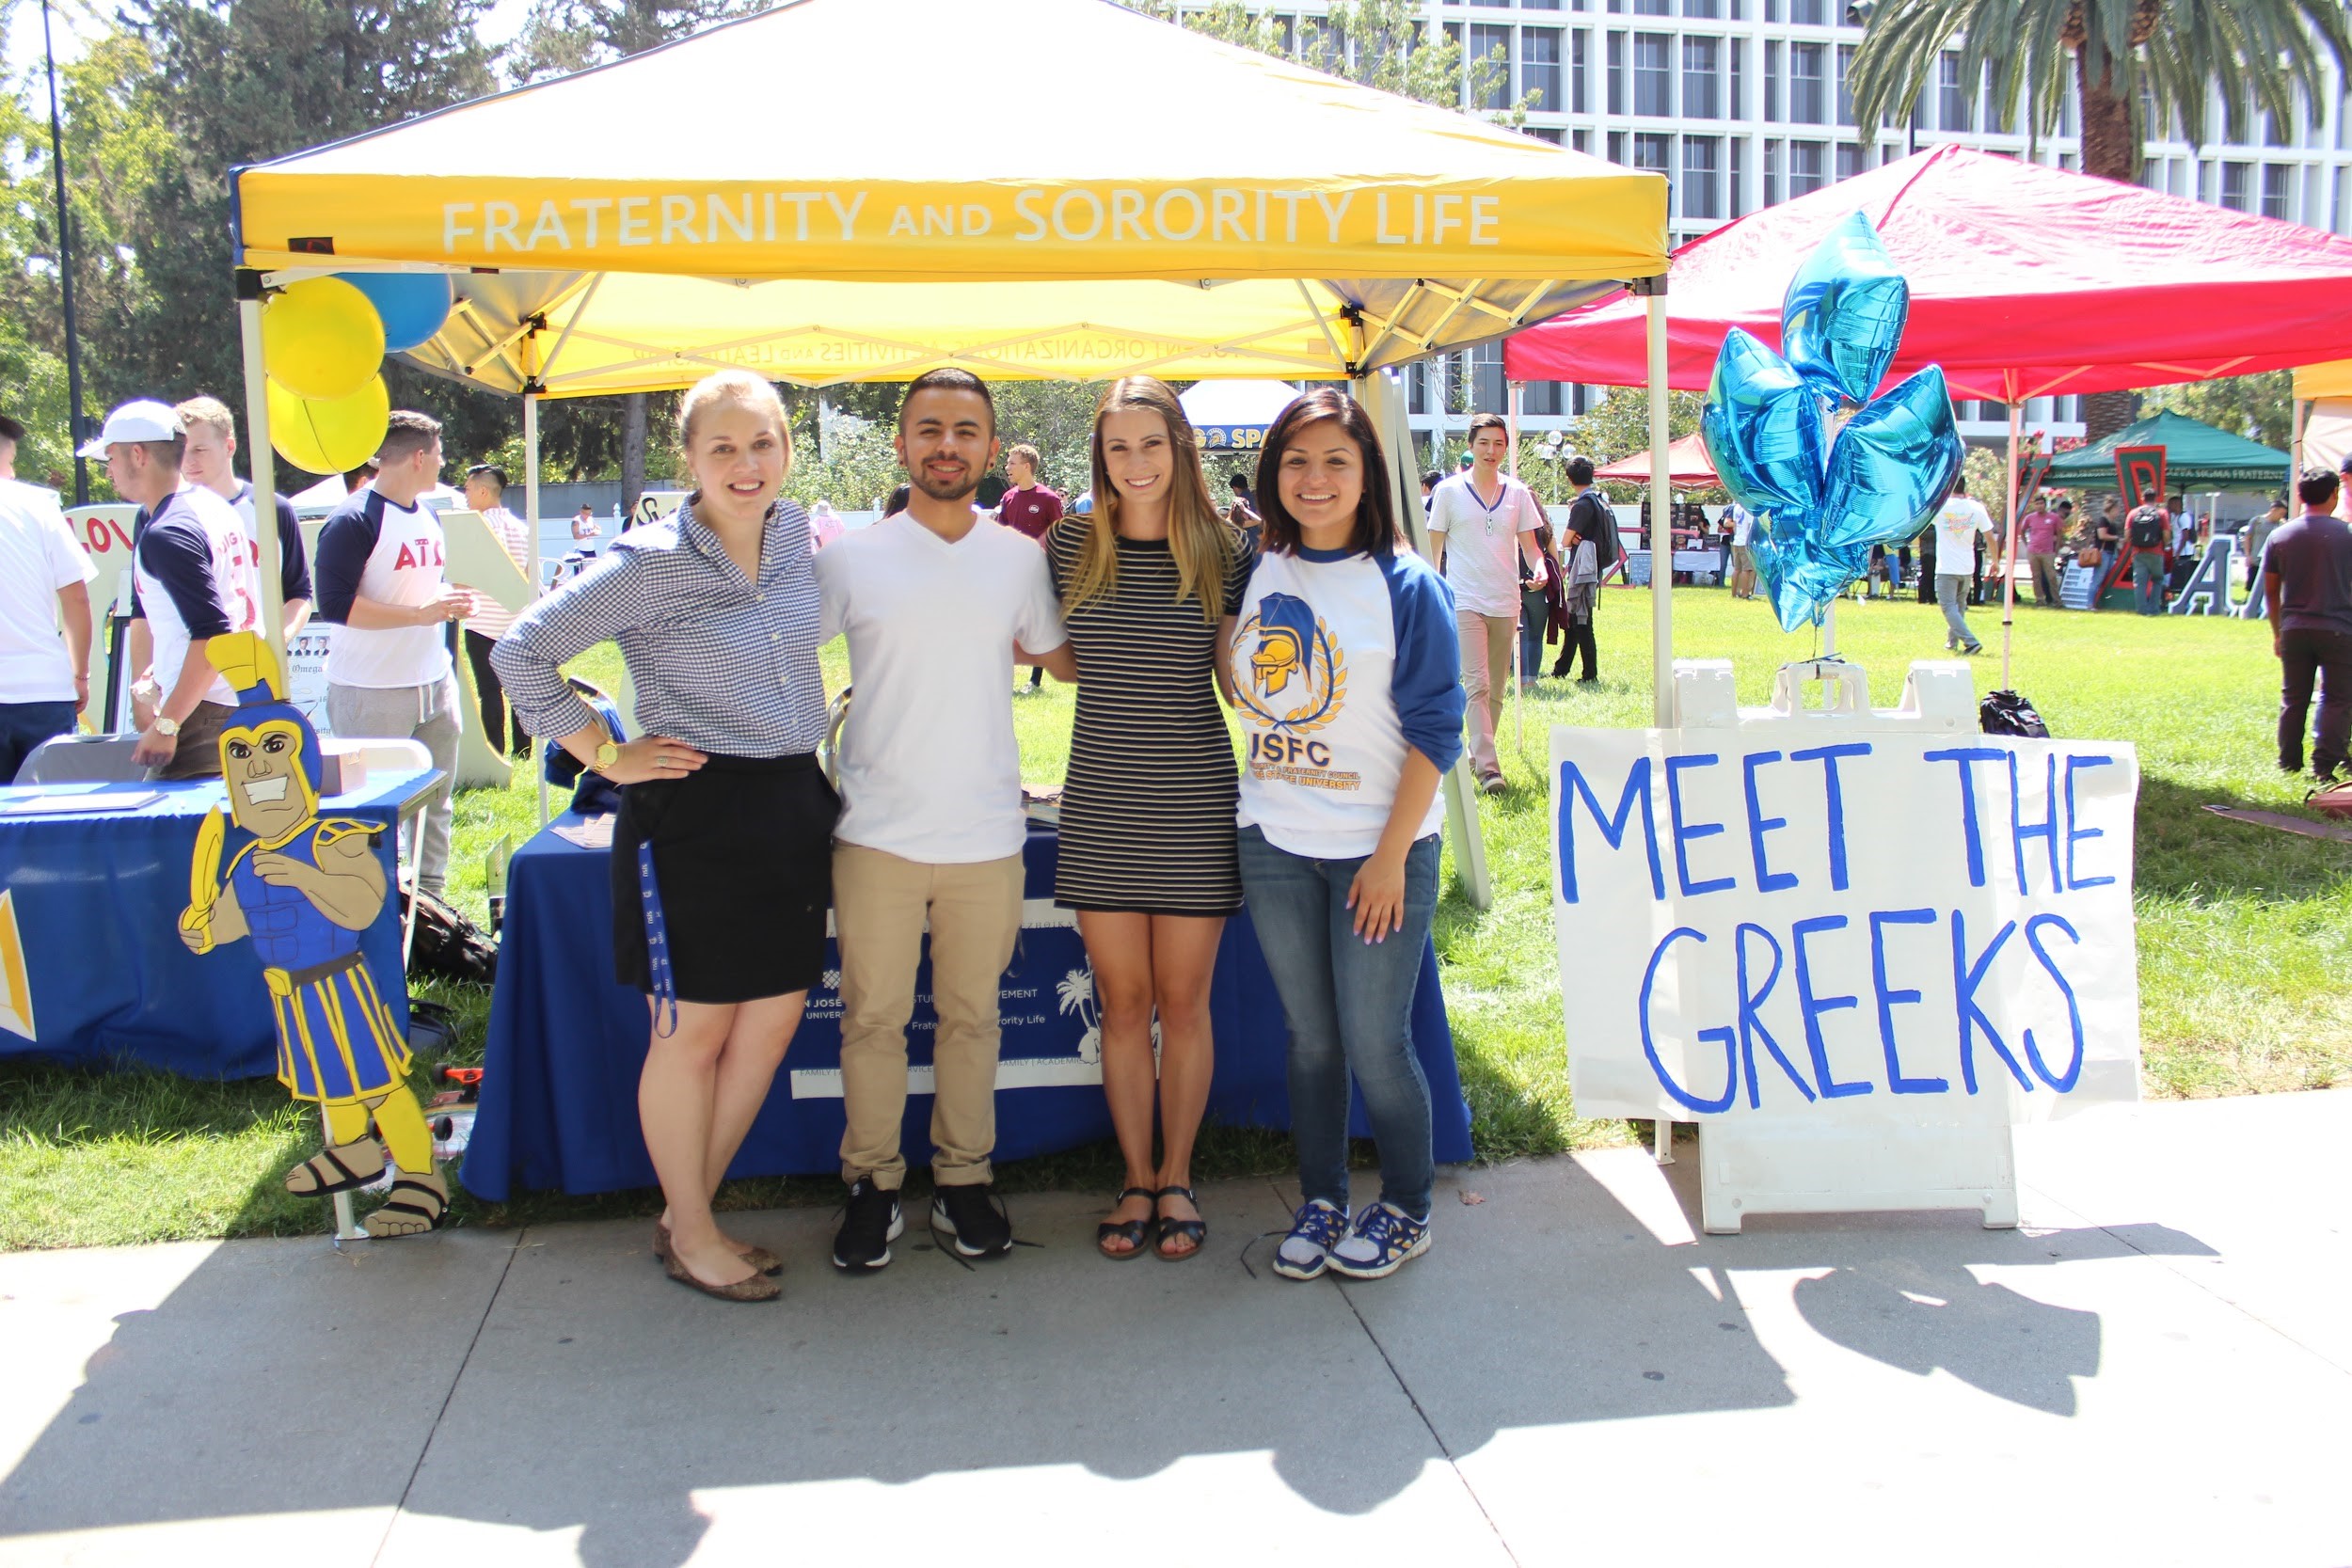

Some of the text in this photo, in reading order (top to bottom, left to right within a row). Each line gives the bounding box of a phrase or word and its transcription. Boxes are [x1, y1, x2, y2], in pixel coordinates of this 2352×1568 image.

[443, 188, 1501, 252] FRATERNITY AND SORORITY LIFE
[1282, 766, 1327, 778] FRATERNITY
[1327, 771, 1361, 781] COUNCIL
[1298, 776, 1362, 791] UNIVERSITY
[1558, 743, 2117, 904] MEET THE
[1026, 1014, 1046, 1024] Life
[1639, 909, 2082, 1114] GREEKS
